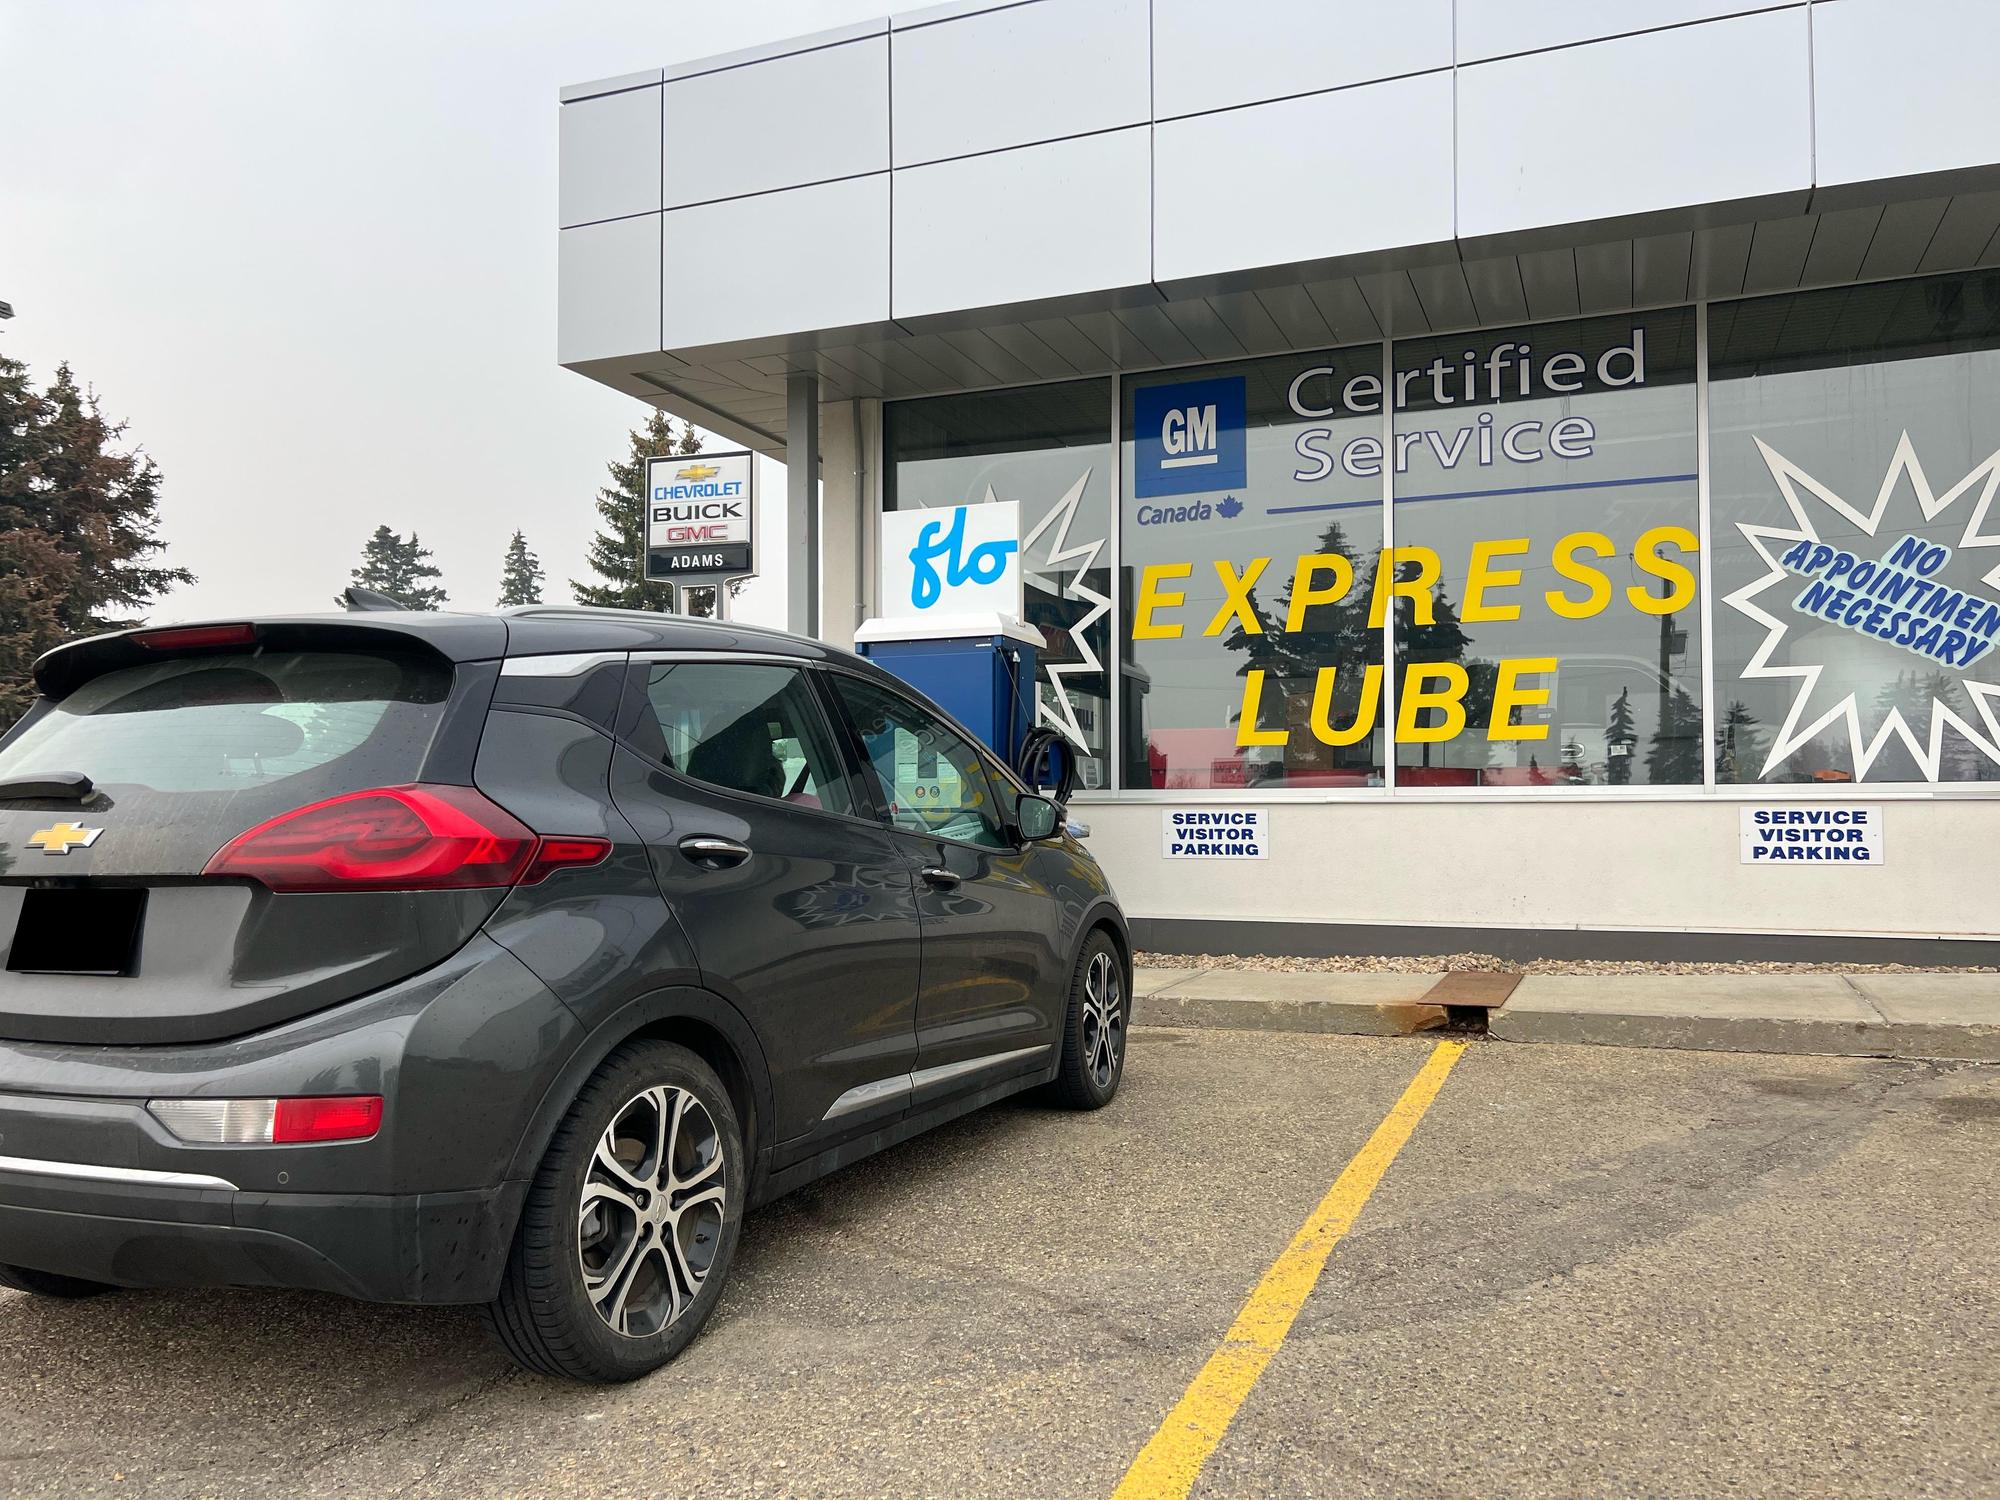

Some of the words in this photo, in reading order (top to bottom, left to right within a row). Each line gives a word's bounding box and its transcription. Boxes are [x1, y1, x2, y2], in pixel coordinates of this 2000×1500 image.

[1287, 328, 1645, 418] Certified
[1162, 404, 1217, 455] GM
[1293, 412, 1596, 482] Service
[654, 481, 742, 500] CHEVROLET
[653, 502, 742, 523] BUICK
[1137, 500, 1212, 526] Canada
[667, 524, 728, 543] GMC
[670, 553, 724, 569] ADAMS
[908, 503, 1018, 608] flo
[1889, 536, 1947, 576] NO
[1131, 524, 1700, 641] EXPRESS
[1782, 539, 2000, 639] APPOINTMEN
[1798, 580, 1989, 667] NECESSARY
[1235, 656, 1559, 748] LUBE
[1172, 812, 1256, 824] SERVICE
[1753, 810, 1868, 826] SERVICE
[1175, 828, 1255, 841] VISITOR
[1759, 828, 1864, 843] VISITOR
[1171, 843, 1259, 857] PARKING
[1752, 846, 1871, 861] PARKING
